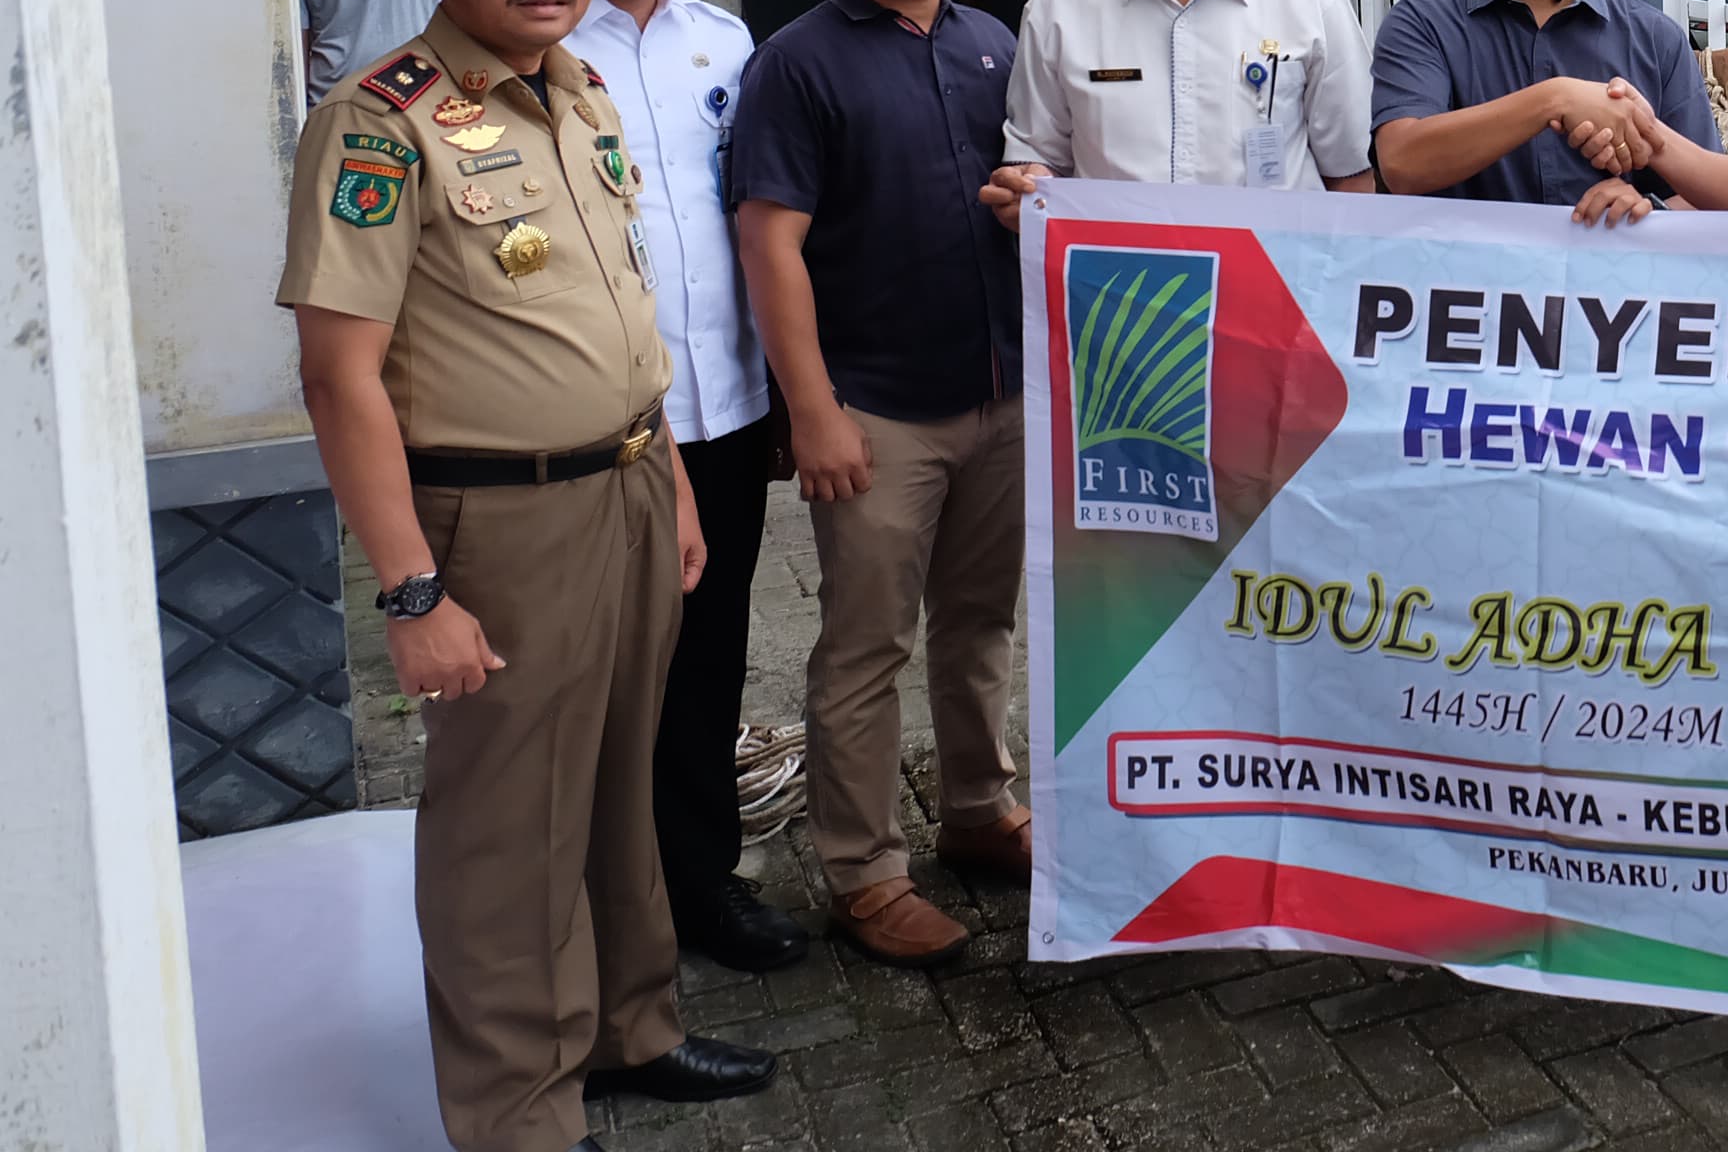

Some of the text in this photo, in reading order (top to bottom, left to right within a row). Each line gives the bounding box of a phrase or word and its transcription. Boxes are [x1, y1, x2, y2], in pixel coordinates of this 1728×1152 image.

[358, 135, 407, 158] RIAU
[1402, 385, 1705, 477] HEWAN
[1082, 457, 1207, 504] FIRST
[1079, 505, 1215, 534] RESOURCES
[1225, 572, 1719, 684] IDUL ADHA
[1400, 685, 1725, 747] 1445H / 2024M
[1127, 755, 1181, 790] PT.
[1197, 753, 1321, 792] SURYA
[1334, 762, 1493, 813] INTISARI
[1509, 785, 1604, 827] RAYA
[1616, 812, 1628, 822] -
[1487, 846, 1679, 893] PEKANBARU,
